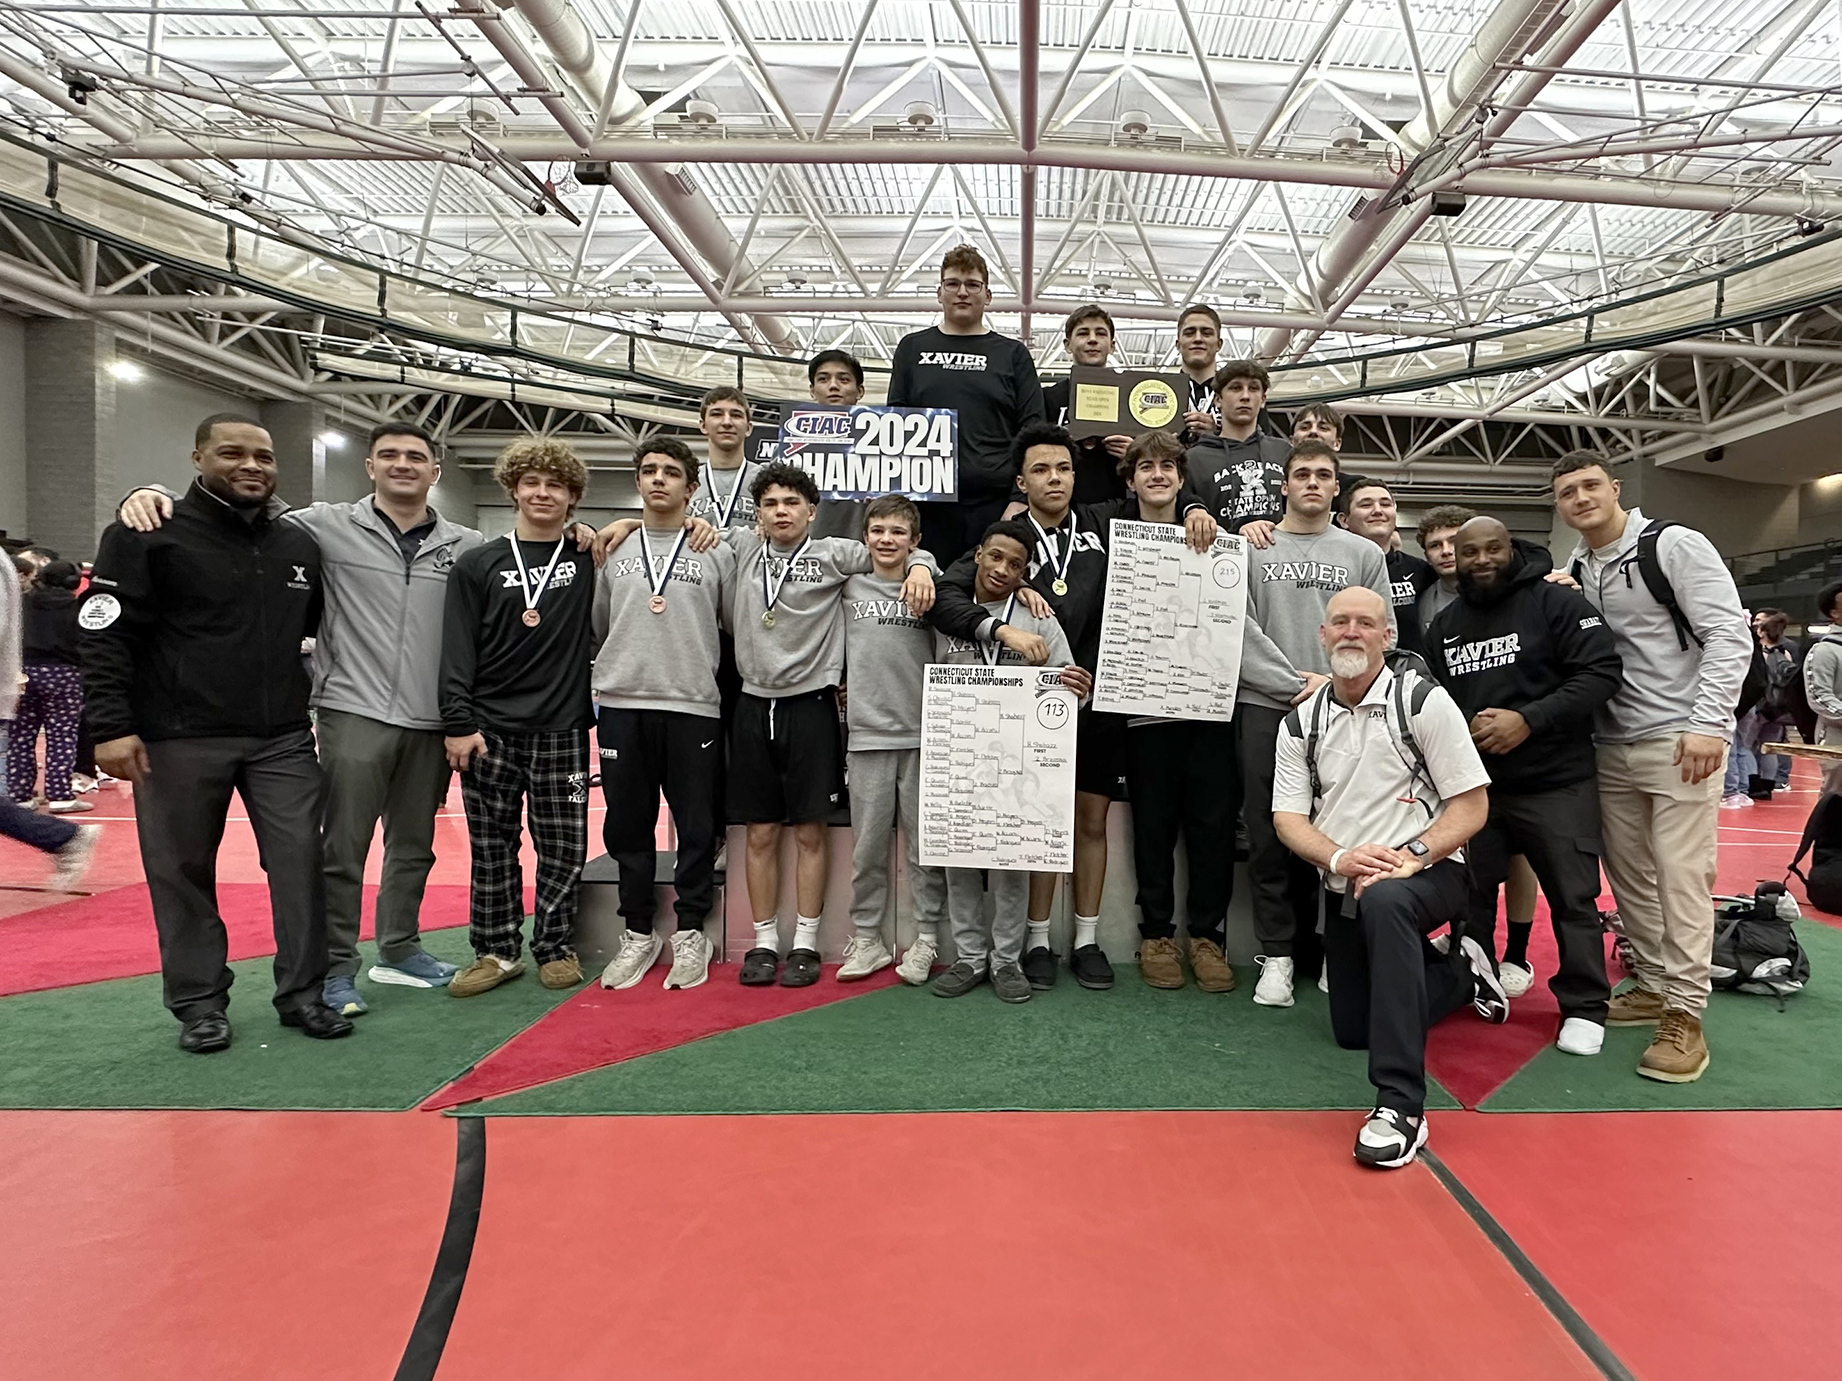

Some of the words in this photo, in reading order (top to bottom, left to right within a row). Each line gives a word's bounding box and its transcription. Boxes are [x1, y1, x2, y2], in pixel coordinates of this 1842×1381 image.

[918, 352, 987, 367] XAVIER
[942, 363, 986, 371] WRESTLING
[1144, 395, 1168, 404] CIAC
[795, 415, 852, 435] CIAC
[855, 412, 953, 457] 2024
[1114, 522, 1156, 533] CONNECTICUT
[1157, 526, 1176, 536] STATE
[1114, 530, 1150, 541] WRESTLING
[1151, 534, 1187, 545] CHAMPIONS
[1217, 538, 1241, 550] CIAC
[291, 565, 308, 582] X
[1220, 567, 1235, 576] 215
[1261, 561, 1349, 584] XAVIER
[1390, 581, 1416, 598] IER
[852, 600, 919, 620] XAVIE
[1444, 632, 1522, 667] XAVIER
[1448, 652, 1516, 677] WRESTLING
[929, 667, 973, 677] CONNECTICUT
[974, 668, 995, 677] STATE
[929, 675, 966, 685] WRESTLING
[967, 677, 1024, 687] CHAMPIONSHIPS
[1041, 674, 1066, 686] CIA
[1044, 703, 1065, 717] 113
[600, 747, 618, 757] VIER
